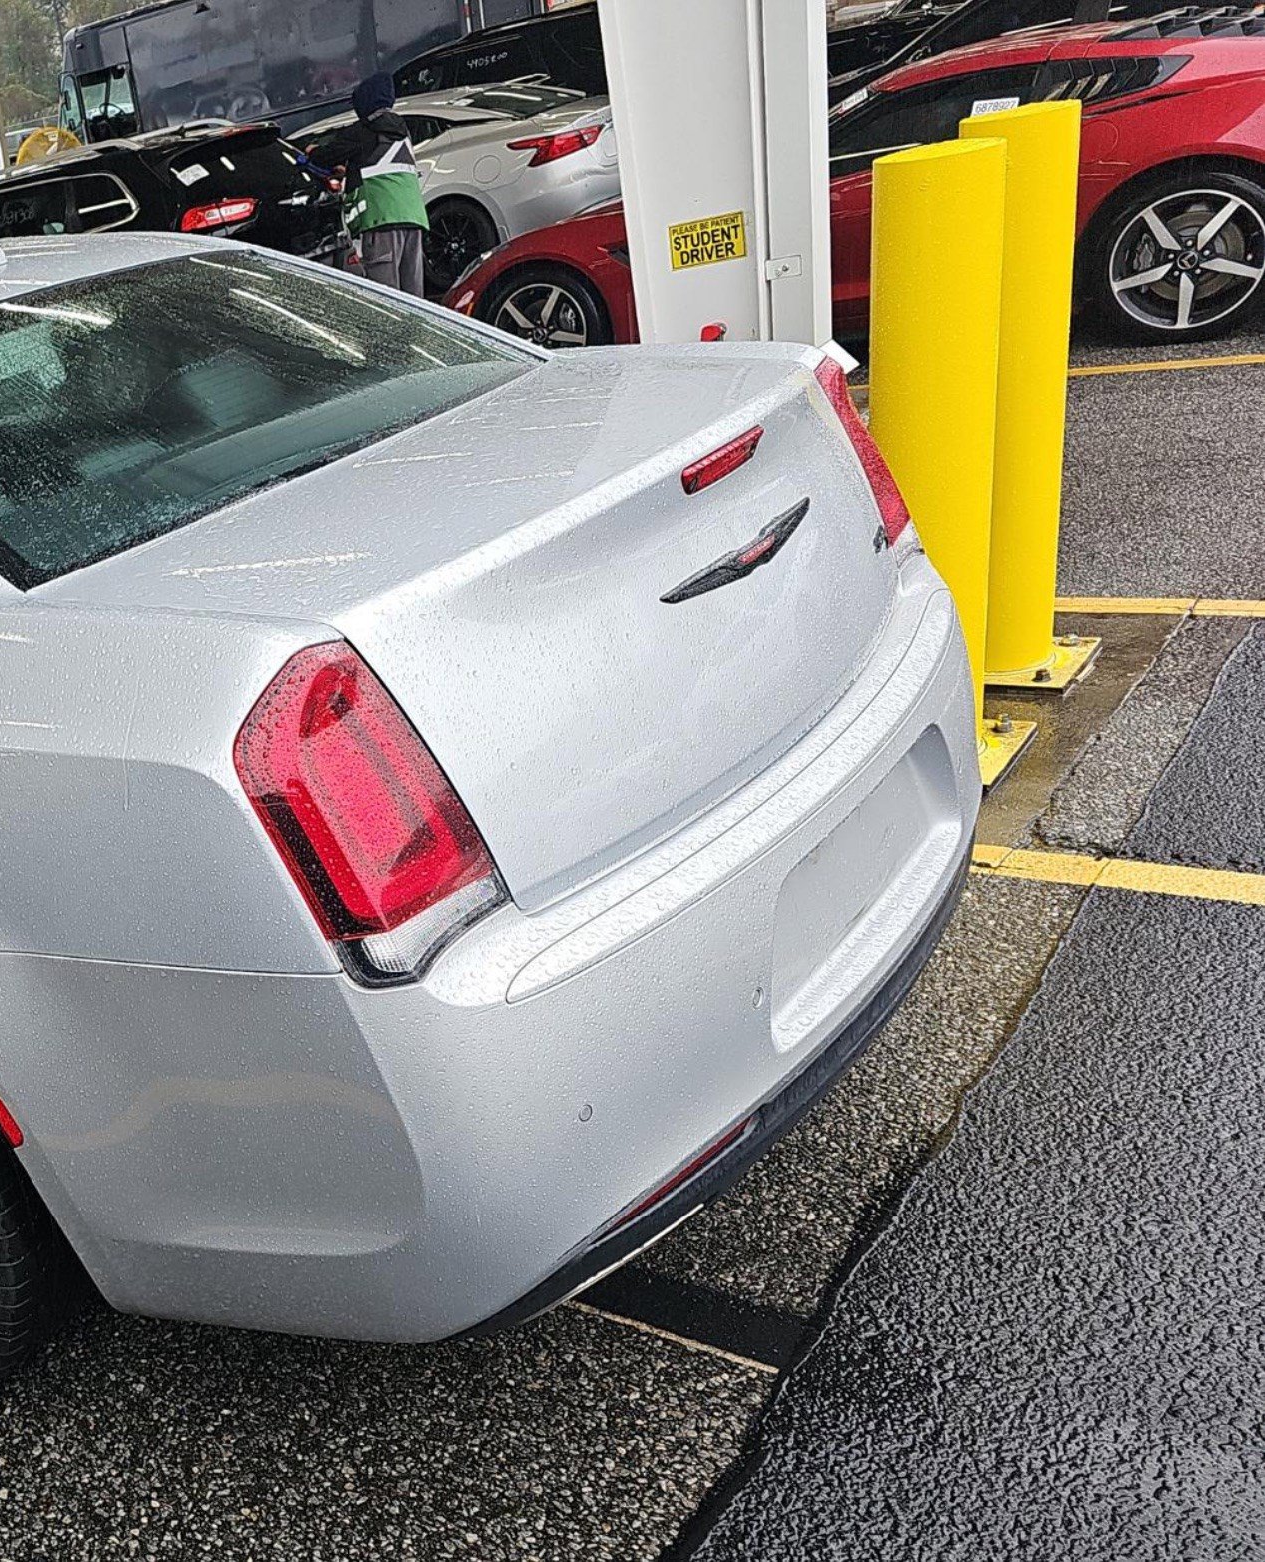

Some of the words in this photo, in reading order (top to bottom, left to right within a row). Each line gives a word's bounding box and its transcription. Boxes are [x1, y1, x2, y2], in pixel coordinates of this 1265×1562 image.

[672, 224, 698, 236] PLEASE
[699, 221, 709, 230] BE
[710, 216, 740, 228] PATIENT
[673, 224, 741, 252] STUDENT
[680, 242, 737, 265] DRIVER
